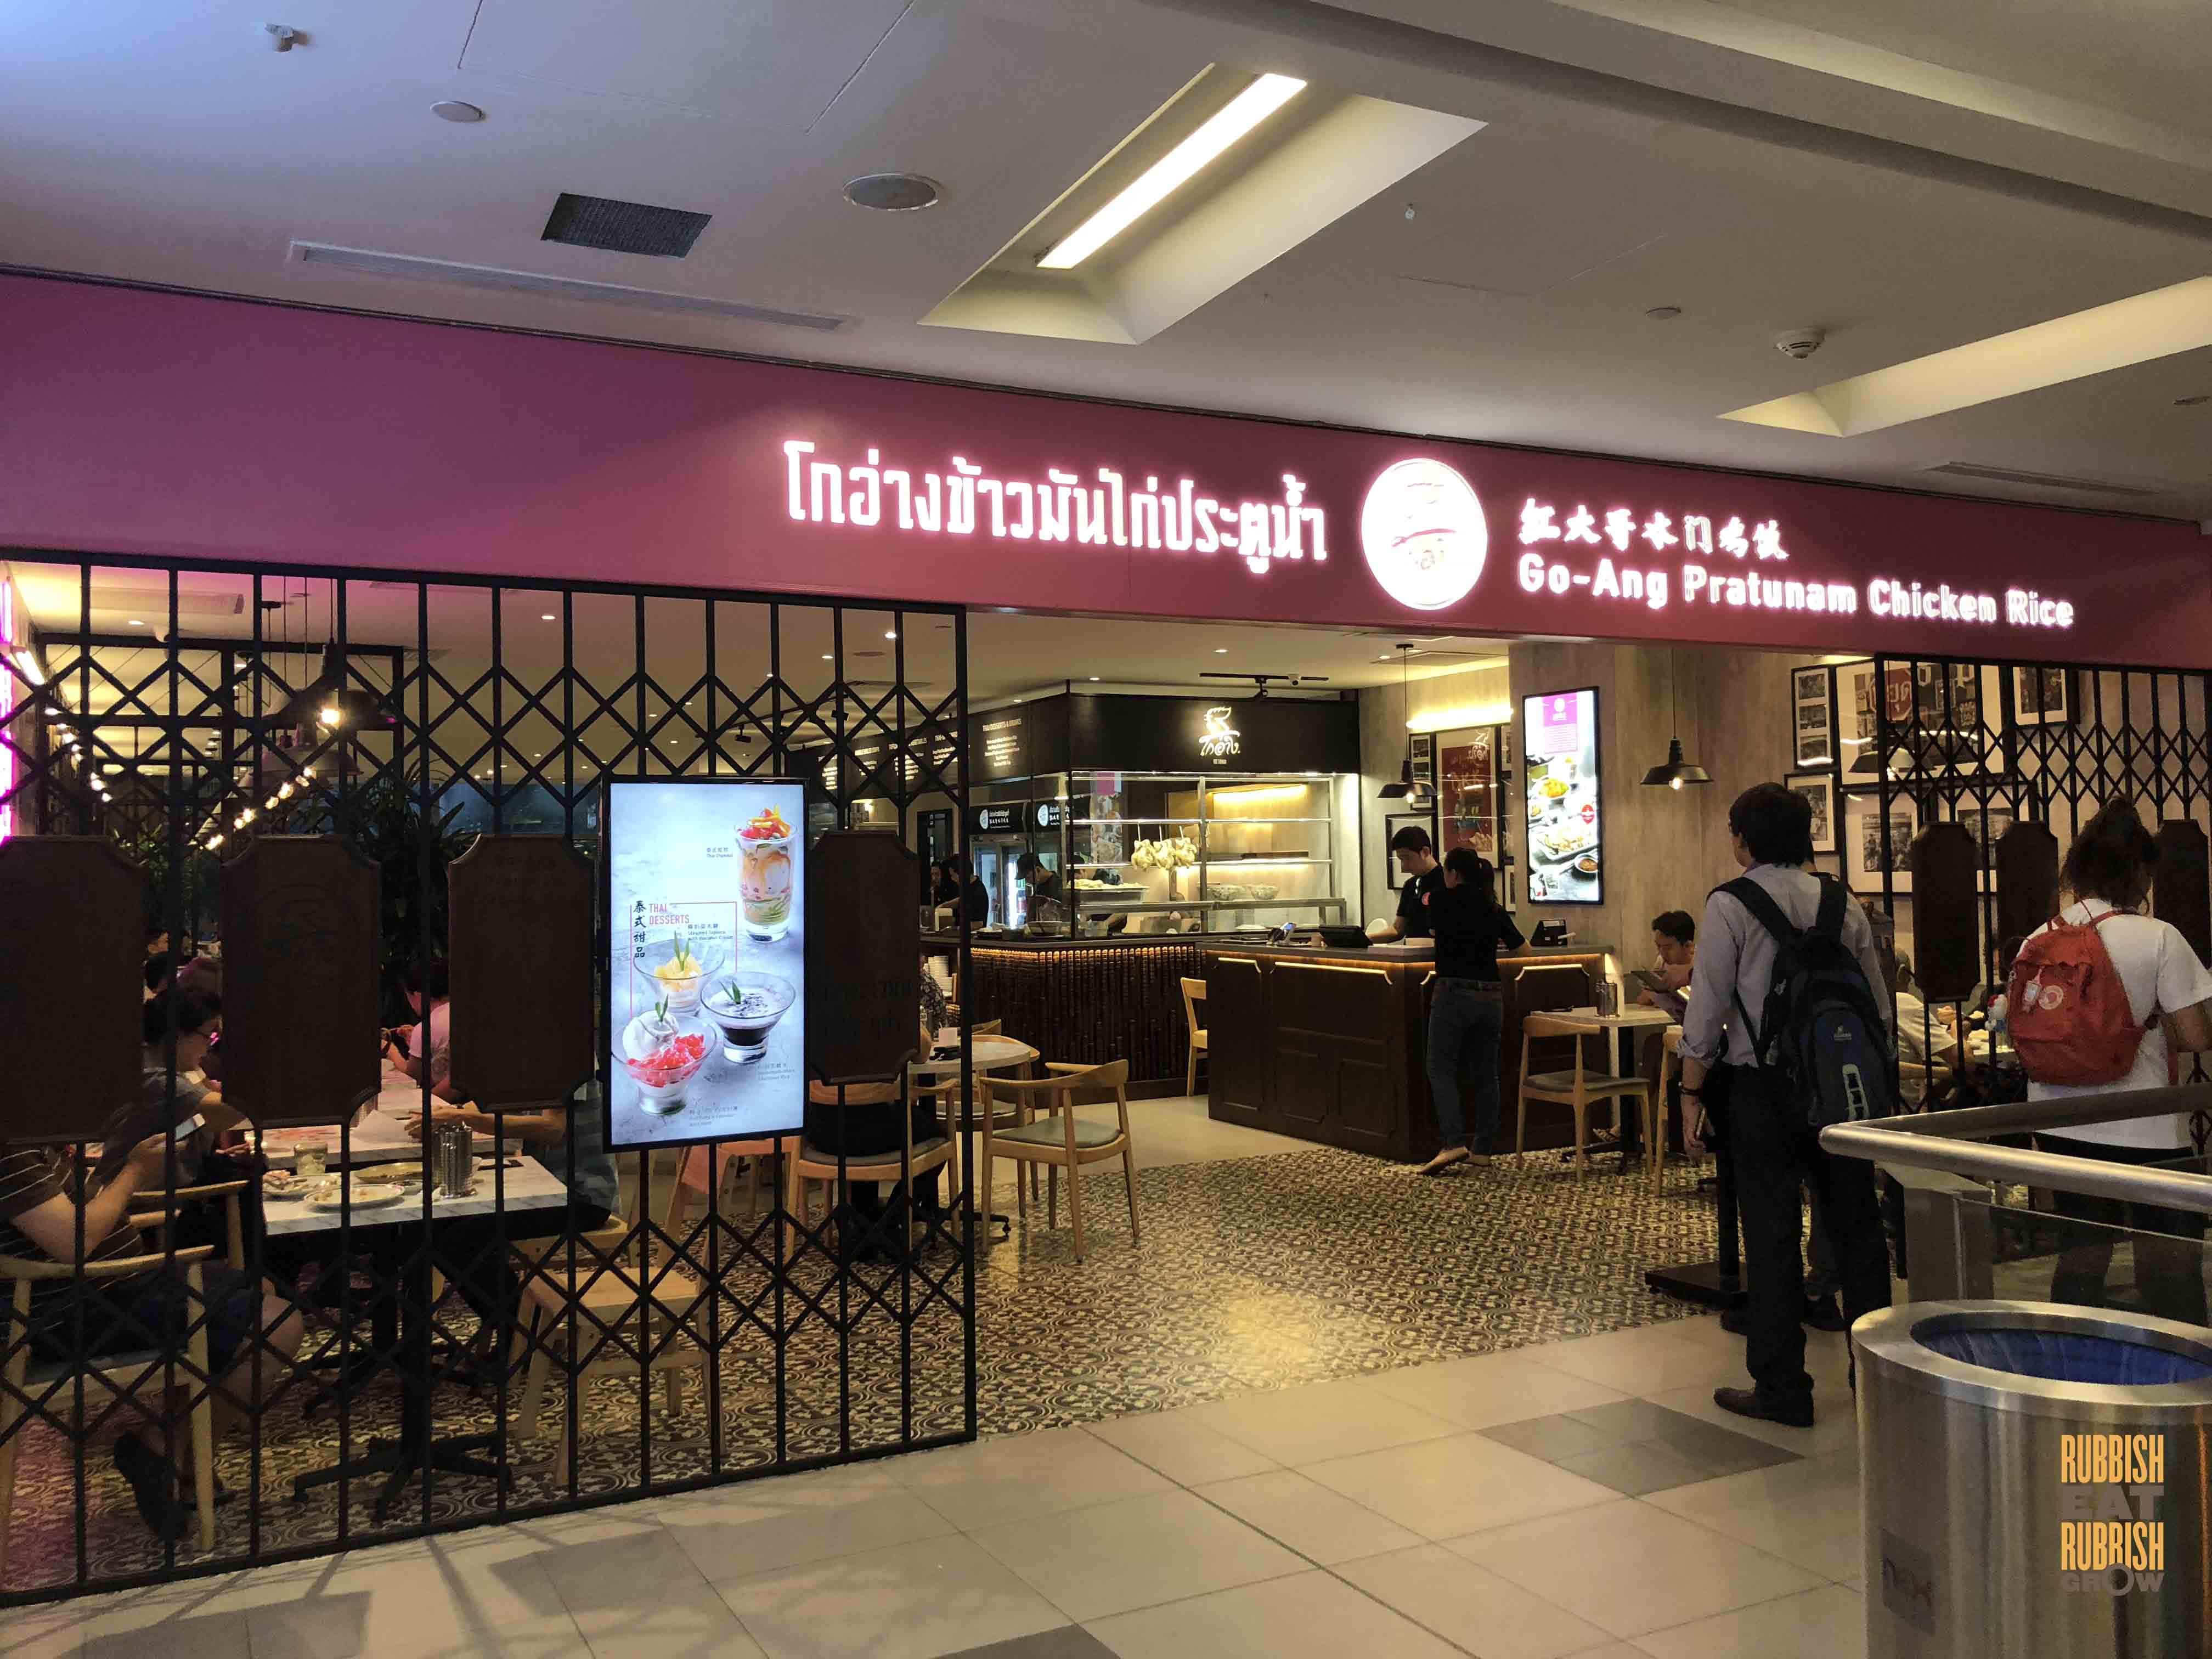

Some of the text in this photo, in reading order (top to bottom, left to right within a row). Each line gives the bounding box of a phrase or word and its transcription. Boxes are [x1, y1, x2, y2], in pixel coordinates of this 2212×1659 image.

[783, 441, 1327, 574] โกอ่างข้าวมันไก่ประตูน้ำ
[1519, 553, 2074, 627] Go-Ang Pratunam Chicken Rice
[633, 900, 646, 958] 泰式甜品
[649, 904, 668, 913] THAI
[649, 914, 690, 925] DESSERTS
